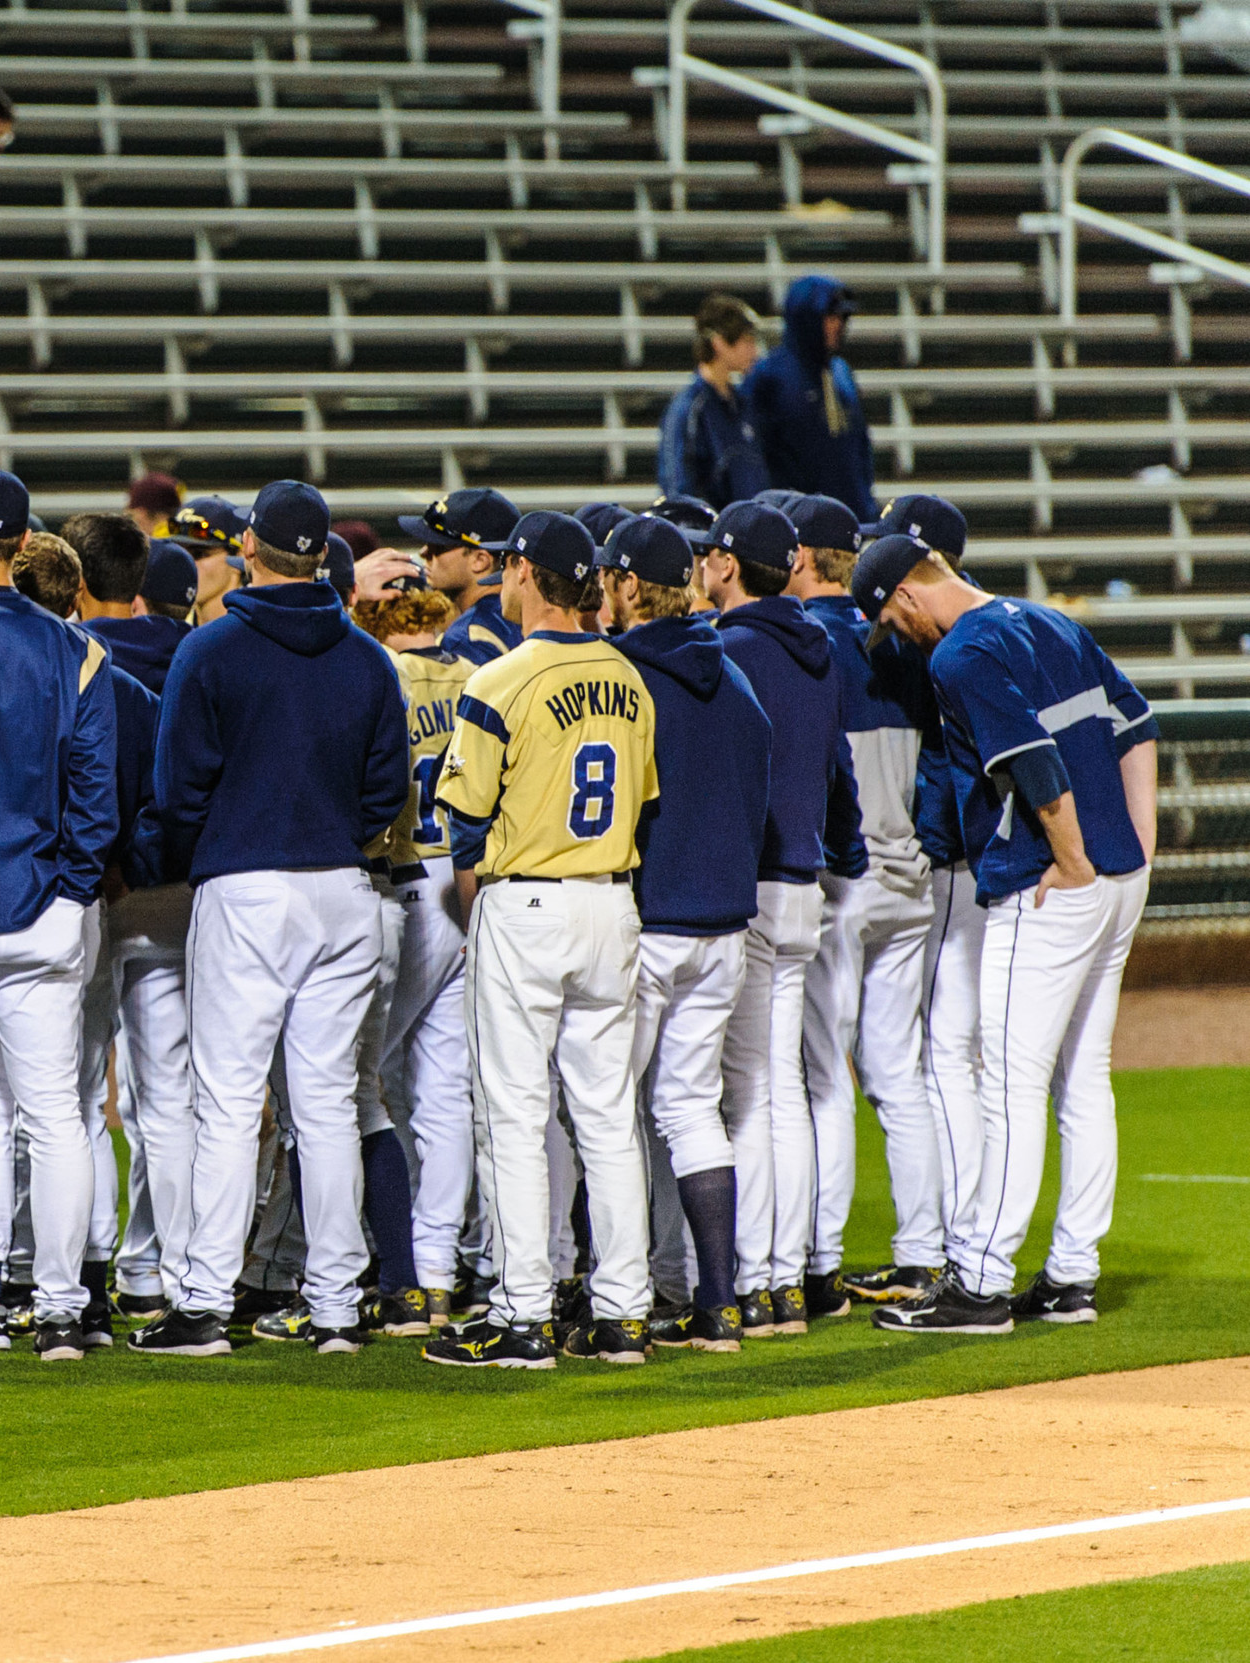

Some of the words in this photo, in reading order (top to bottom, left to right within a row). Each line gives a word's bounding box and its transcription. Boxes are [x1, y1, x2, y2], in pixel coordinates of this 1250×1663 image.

[545, 681, 639, 731] HOPKINS
[411, 754, 450, 846] 1
[566, 741, 617, 840] 8
